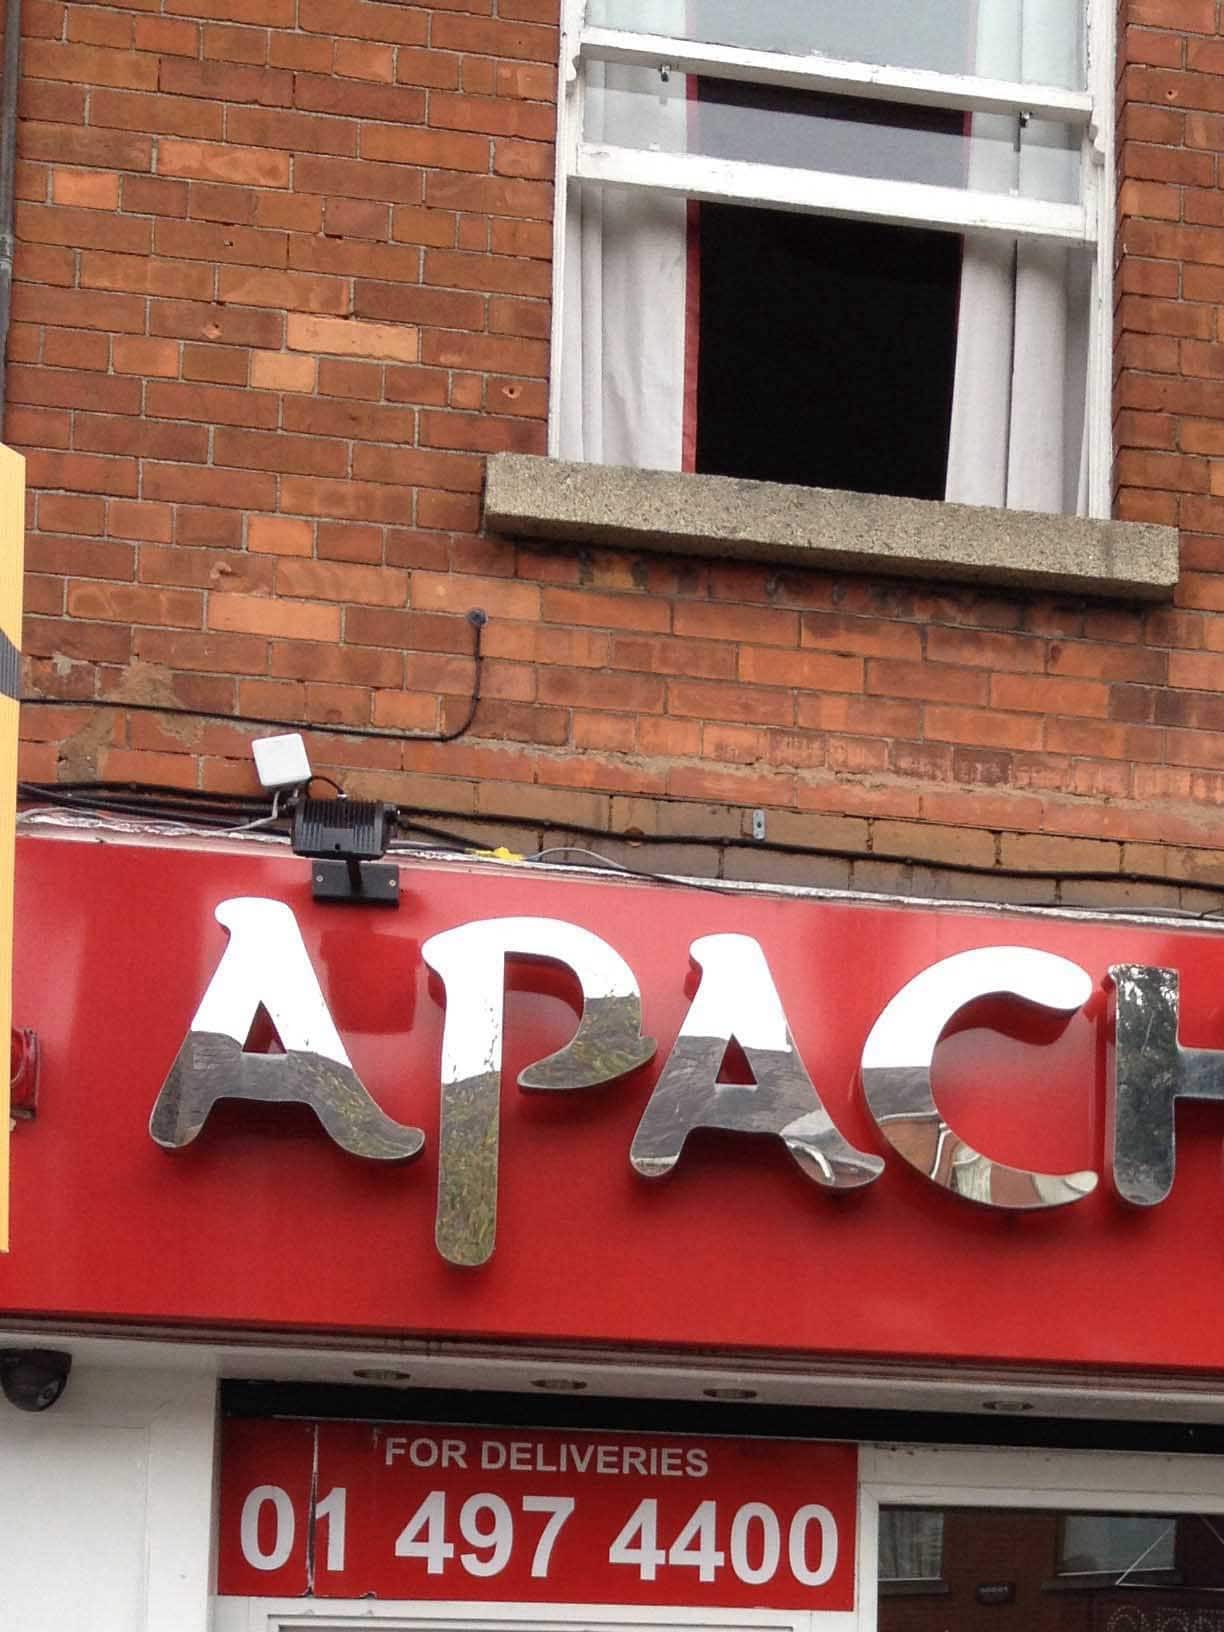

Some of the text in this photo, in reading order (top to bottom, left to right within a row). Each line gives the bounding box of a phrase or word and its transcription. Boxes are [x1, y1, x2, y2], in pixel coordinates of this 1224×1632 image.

[385, 1437, 709, 1477] FOR DELIVERIES
[240, 1485, 838, 1586] 01 497 4400
